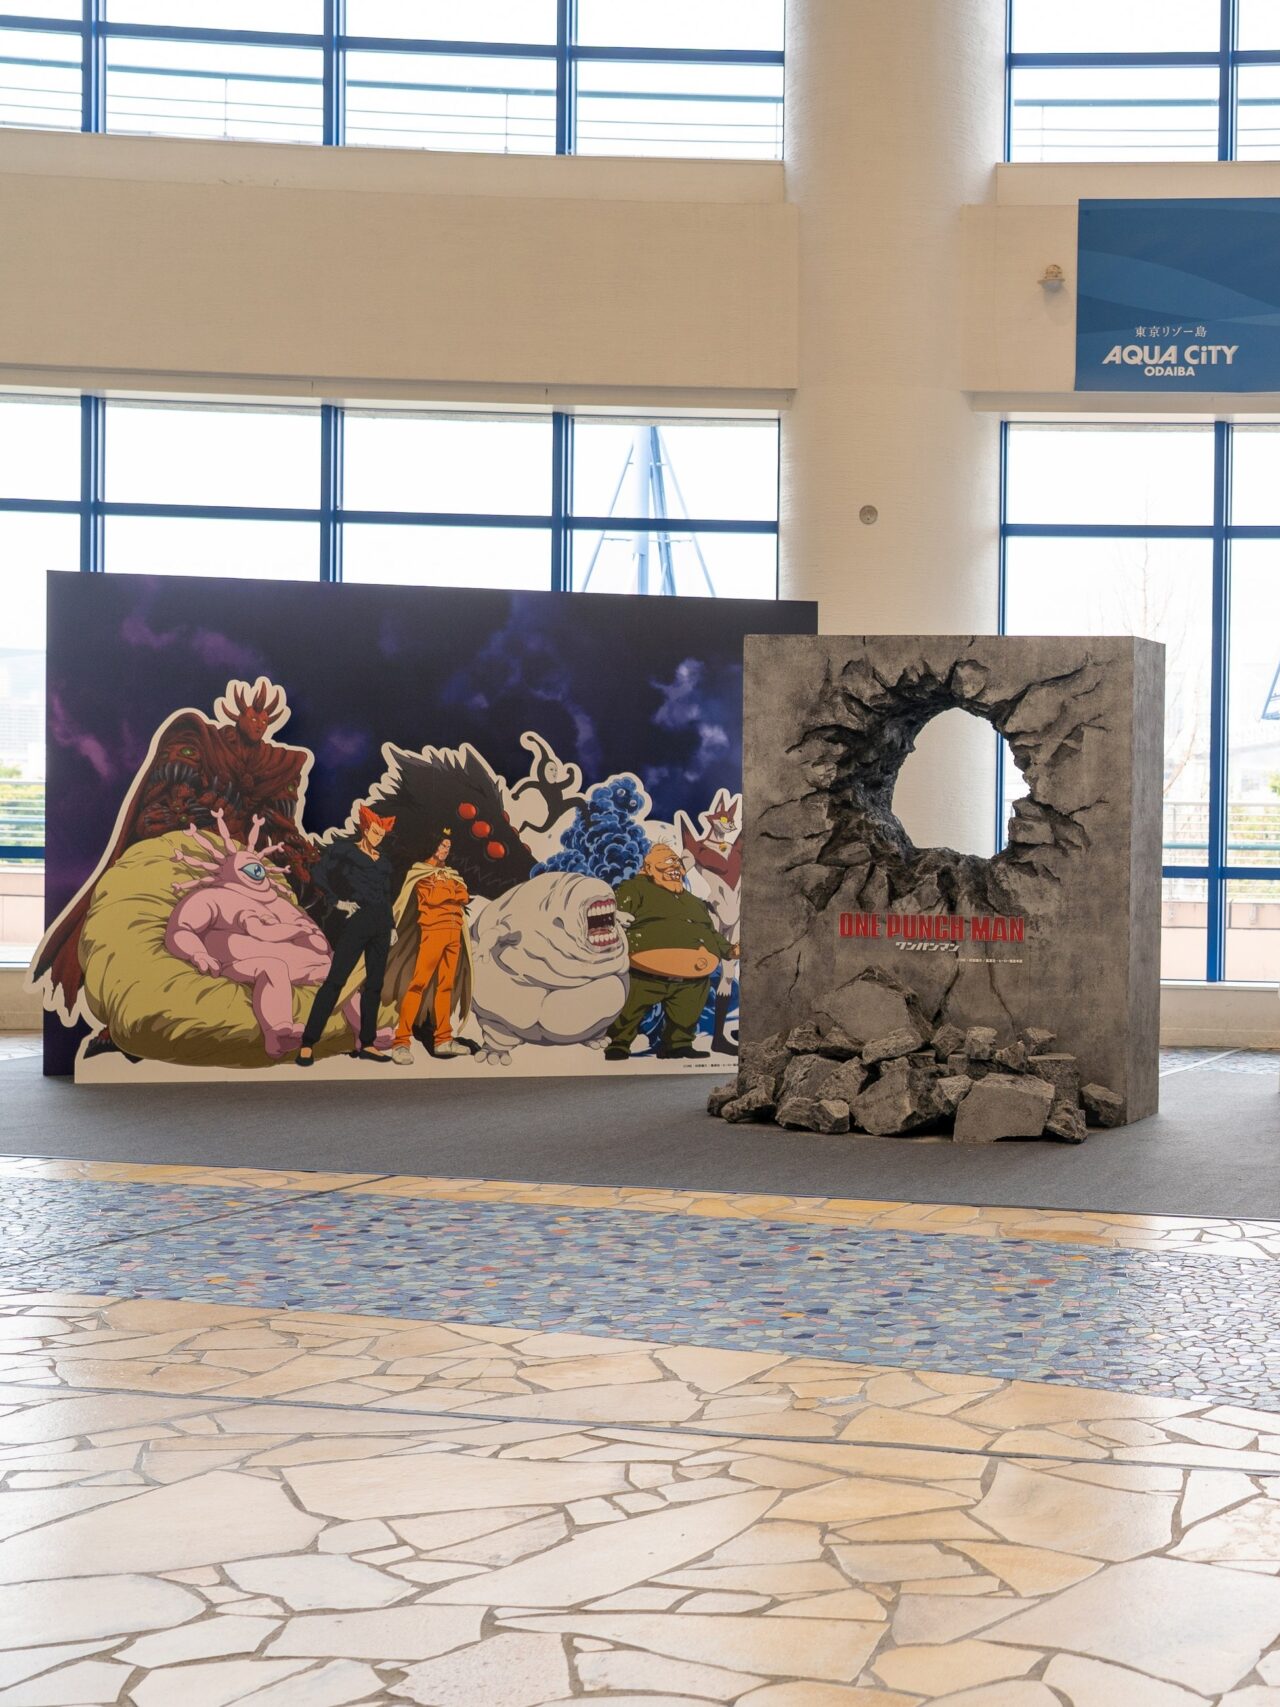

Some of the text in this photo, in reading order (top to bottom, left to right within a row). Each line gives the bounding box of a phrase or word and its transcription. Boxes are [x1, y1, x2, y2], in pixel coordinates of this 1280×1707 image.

[1135, 326, 1207, 338] 東京リゾー島
[1102, 345, 1177, 365] AQUA
[1144, 366, 1195, 376] ODAIBA
[838, 912, 1025, 942] ONE PUNCH MAN
[895, 942, 960, 951] ワンパンマン
